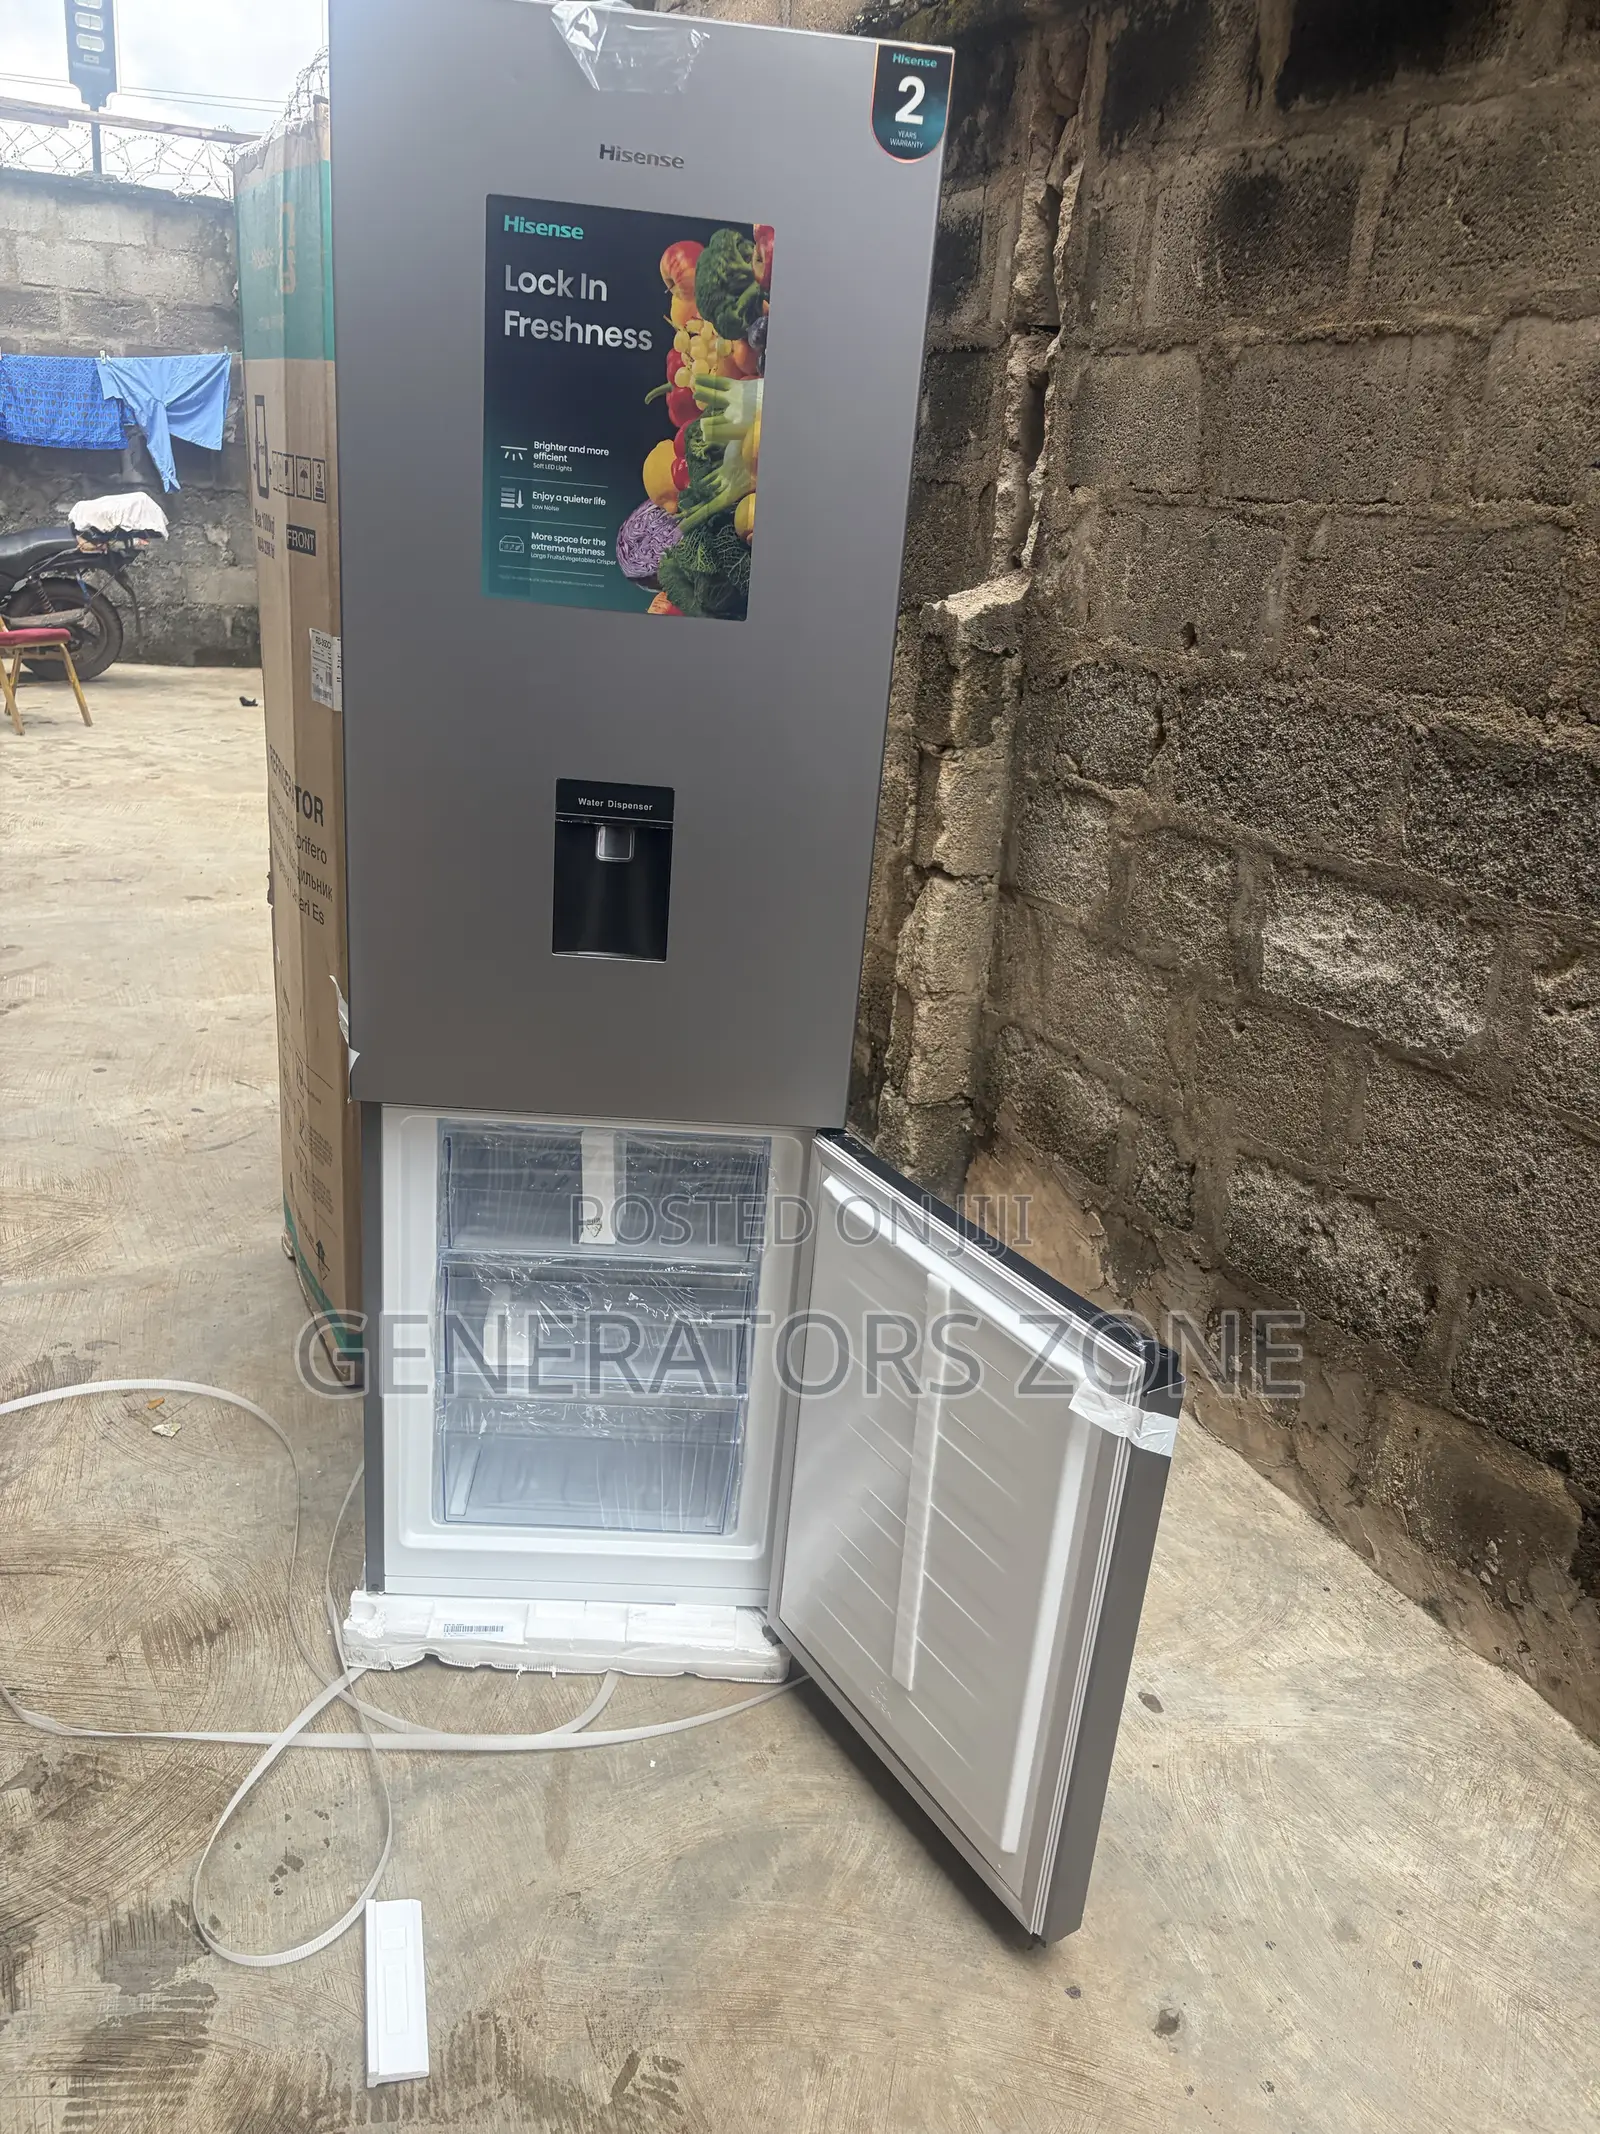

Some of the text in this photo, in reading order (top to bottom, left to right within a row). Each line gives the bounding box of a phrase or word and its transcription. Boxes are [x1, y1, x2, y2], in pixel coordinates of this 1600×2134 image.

[892, 53, 938, 68] Hisense
[895, 75, 925, 125] 2
[898, 130, 917, 140] YEARS
[890, 138, 924, 149] WARRANTY
[599, 144, 685, 169] Hisense
[503, 215, 584, 240] Hisense
[505, 265, 608, 302] Lock In
[504, 309, 653, 351] Freshness
[533, 441, 609, 456] Brighter and more
[533, 452, 568, 463] efficient
[545, 463, 556, 471] LED
[532, 491, 555, 503] Enjoy
[562, 495, 592, 504] quieter
[593, 496, 606, 506] life
[286, 529, 315, 551] FRONT
[531, 532, 607, 547] More space for the
[531, 543, 606, 557] extreme freshness
[530, 552, 546, 560] Large
[596, 558, 617, 566] Crisper
[578, 797, 653, 811] Water Dispenser
